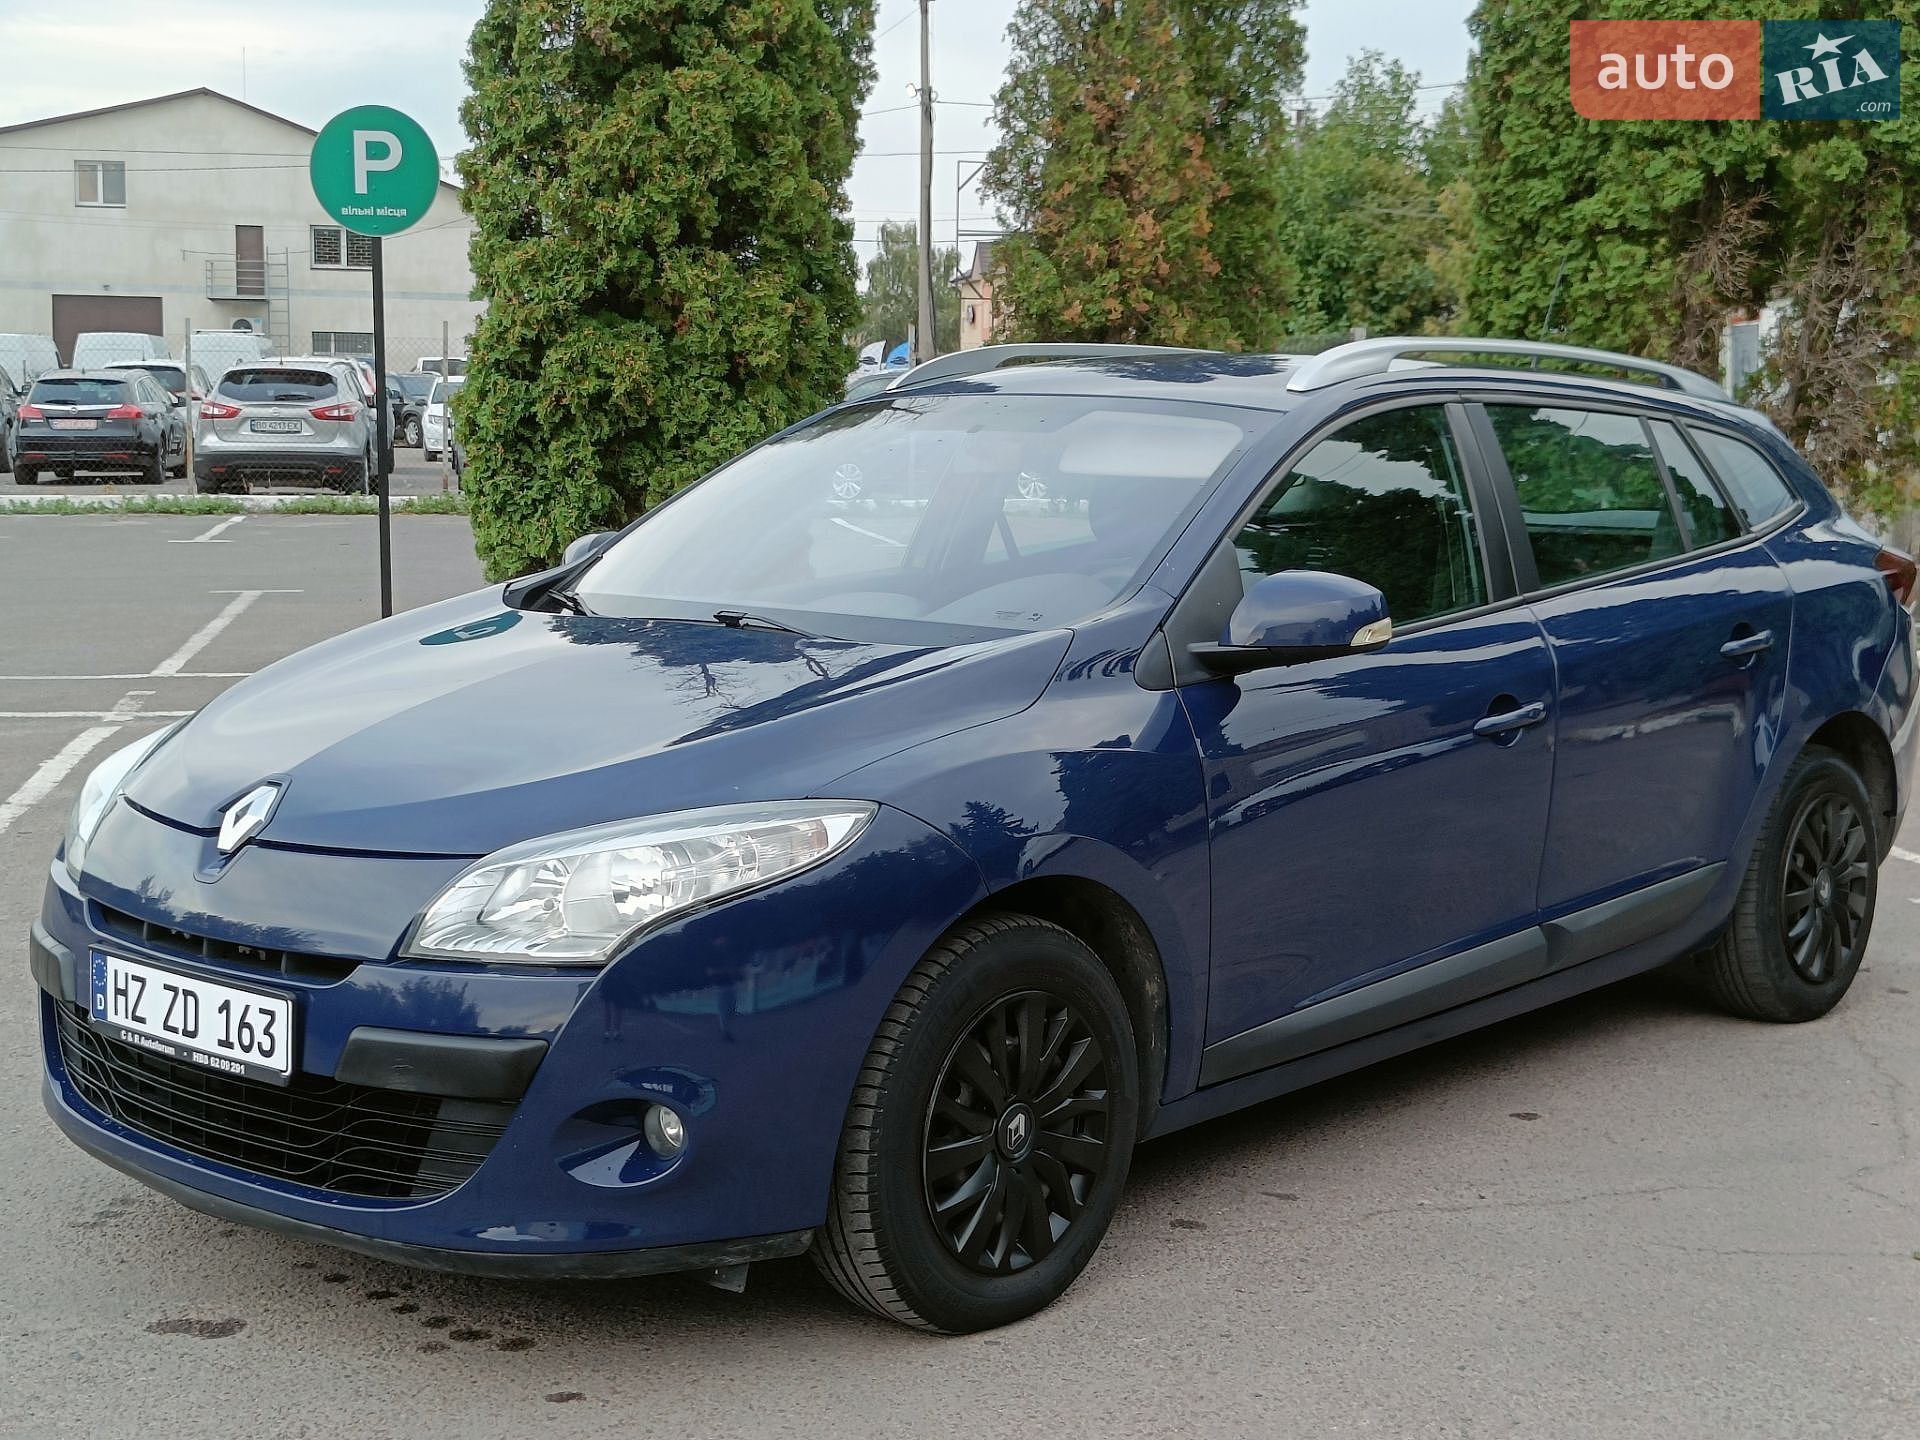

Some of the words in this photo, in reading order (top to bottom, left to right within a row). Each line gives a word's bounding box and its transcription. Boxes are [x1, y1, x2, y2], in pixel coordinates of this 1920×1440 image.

[353, 130, 403, 195] P
[341, 205, 374, 216] вільні
[376, 206, 407, 218] місця
[96, 993, 105, 1010] D
[113, 969, 147, 1025] HZ
[162, 984, 200, 1039] ZD
[217, 999, 276, 1059] 163
